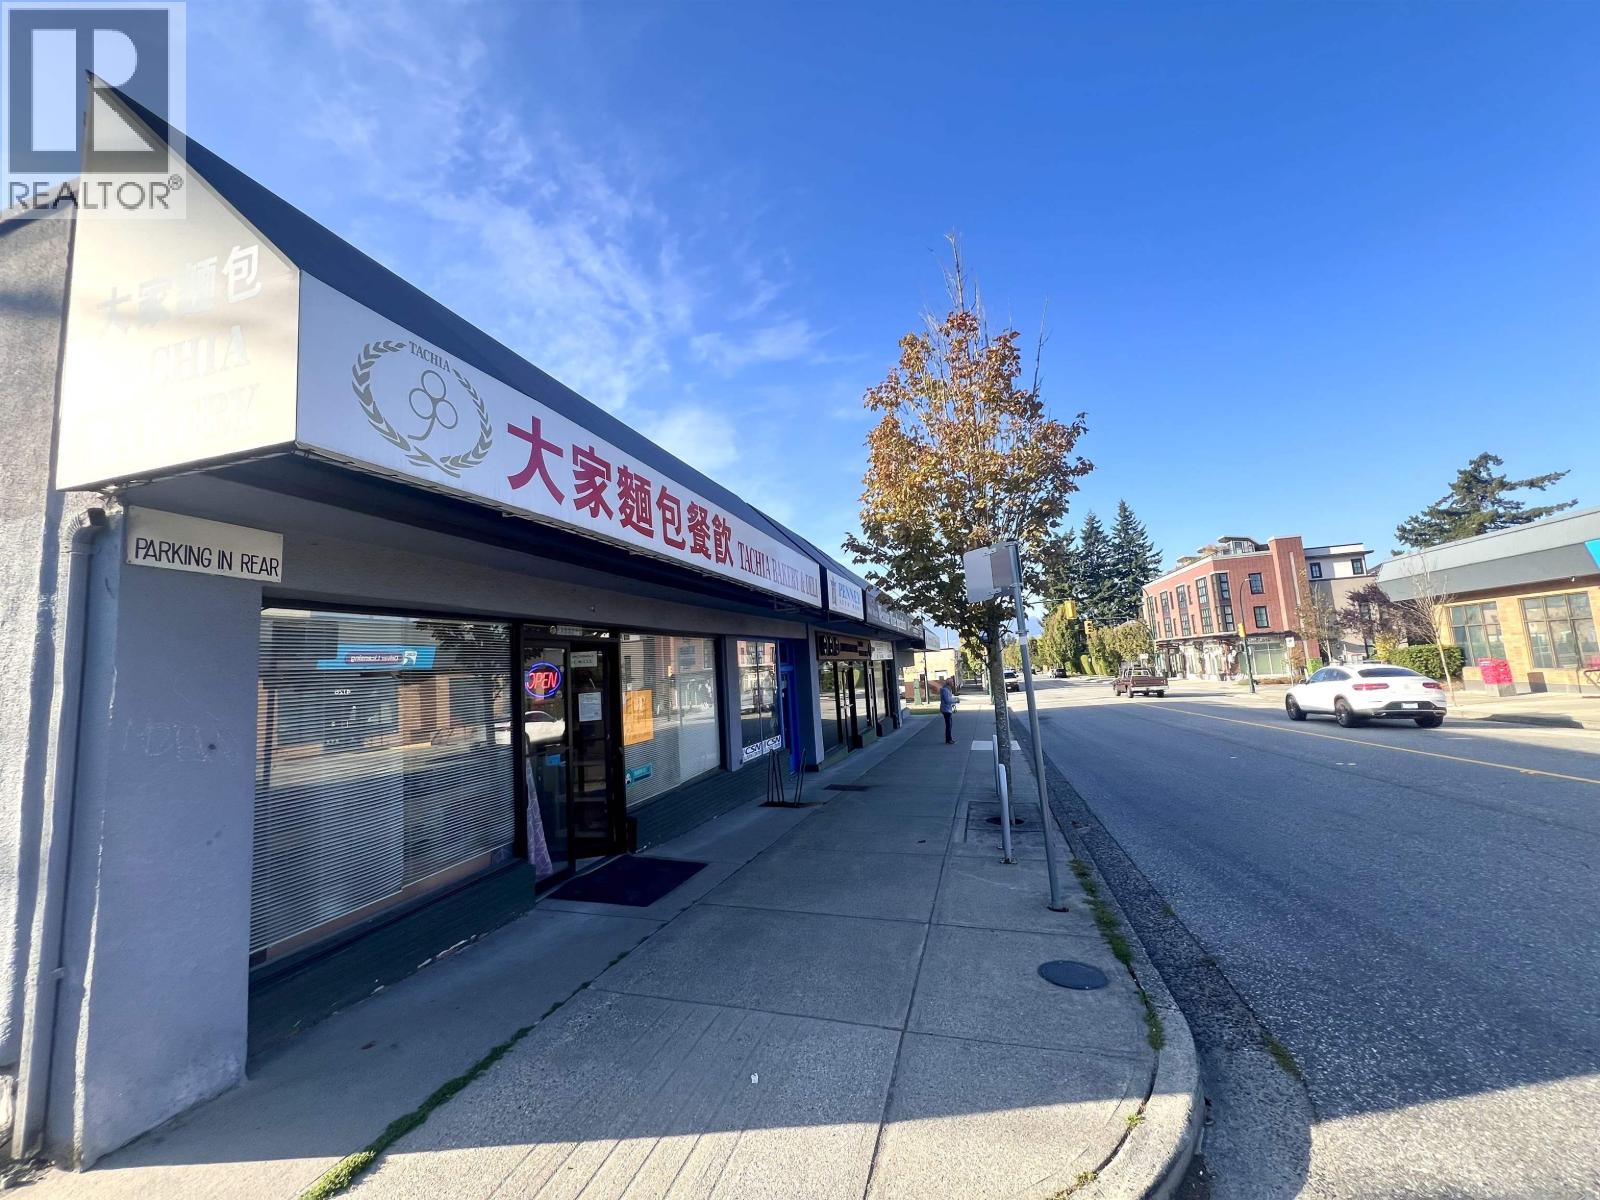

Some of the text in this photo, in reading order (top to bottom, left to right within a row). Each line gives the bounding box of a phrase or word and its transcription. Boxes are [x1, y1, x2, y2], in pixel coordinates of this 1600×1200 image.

[409, 341, 451, 373] TACHIA
[507, 416, 734, 567] 大家麵包餐飲
[135, 537, 279, 577] PARKING IN REAR
[737, 541, 771, 581] TACHIA
[772, 558, 799, 591] BAKERY
[526, 671, 558, 689] OPEN
[745, 742, 762, 754] CSN
[767, 735, 781, 747] CSN
